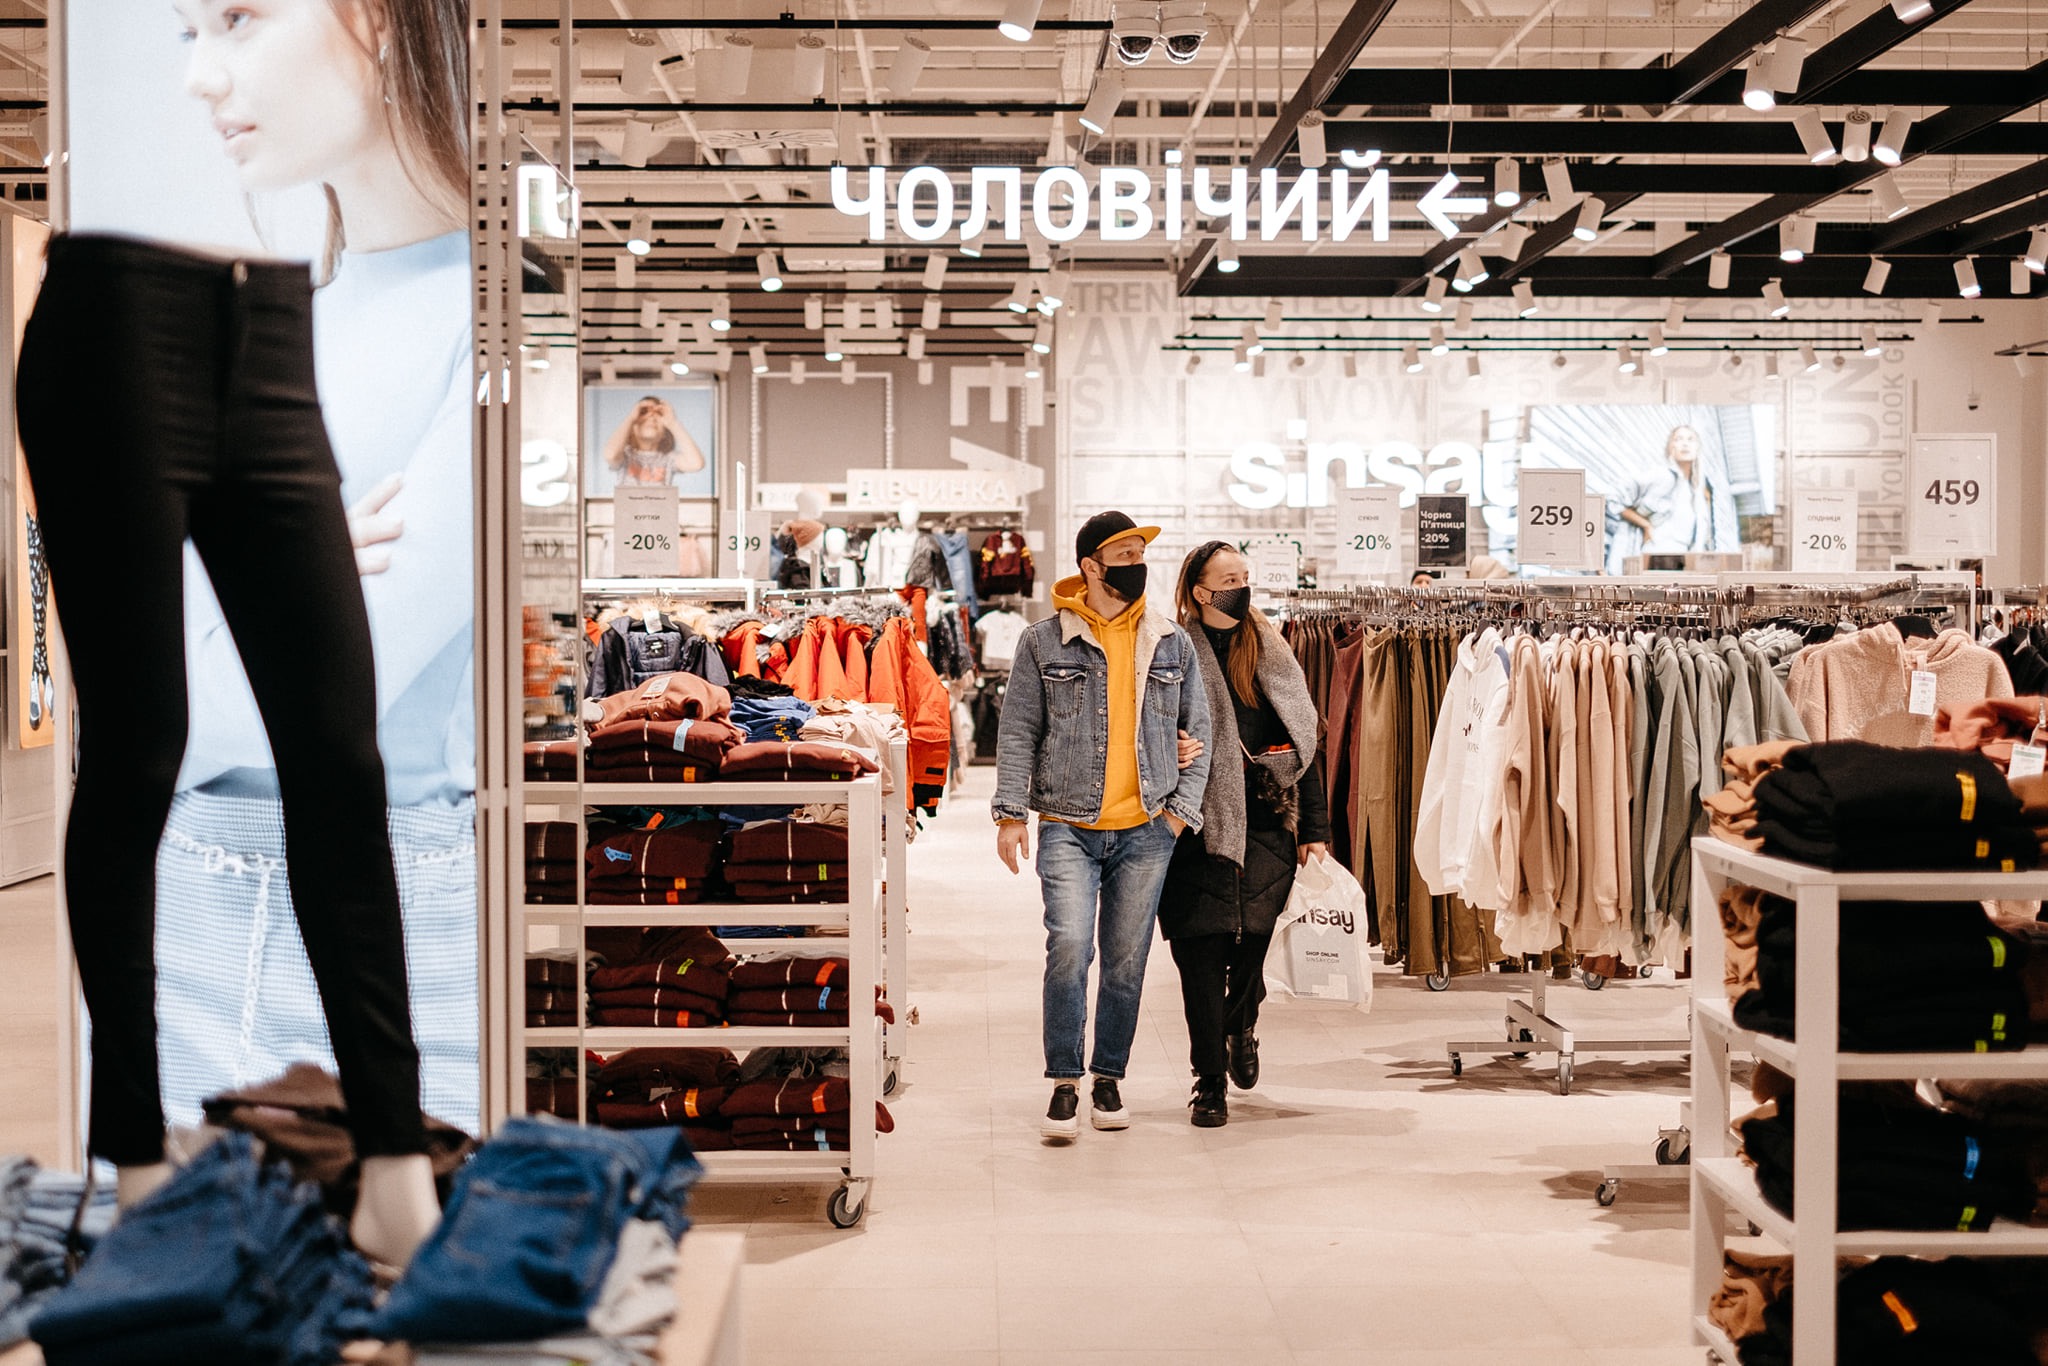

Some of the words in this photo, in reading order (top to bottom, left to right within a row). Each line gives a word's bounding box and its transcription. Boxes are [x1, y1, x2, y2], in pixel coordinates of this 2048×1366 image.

[1925, 479, 1979, 505] 459
[1420, 511, 1452, 520] Чорна
[1530, 505, 1573, 526] 259
[624, 534, 671, 551] -20%
[1346, 534, 1392, 550] -20%
[1421, 533, 1449, 543] -20%
[1801, 534, 1847, 551] -20%
[1291, 908, 1354, 935] nsay
